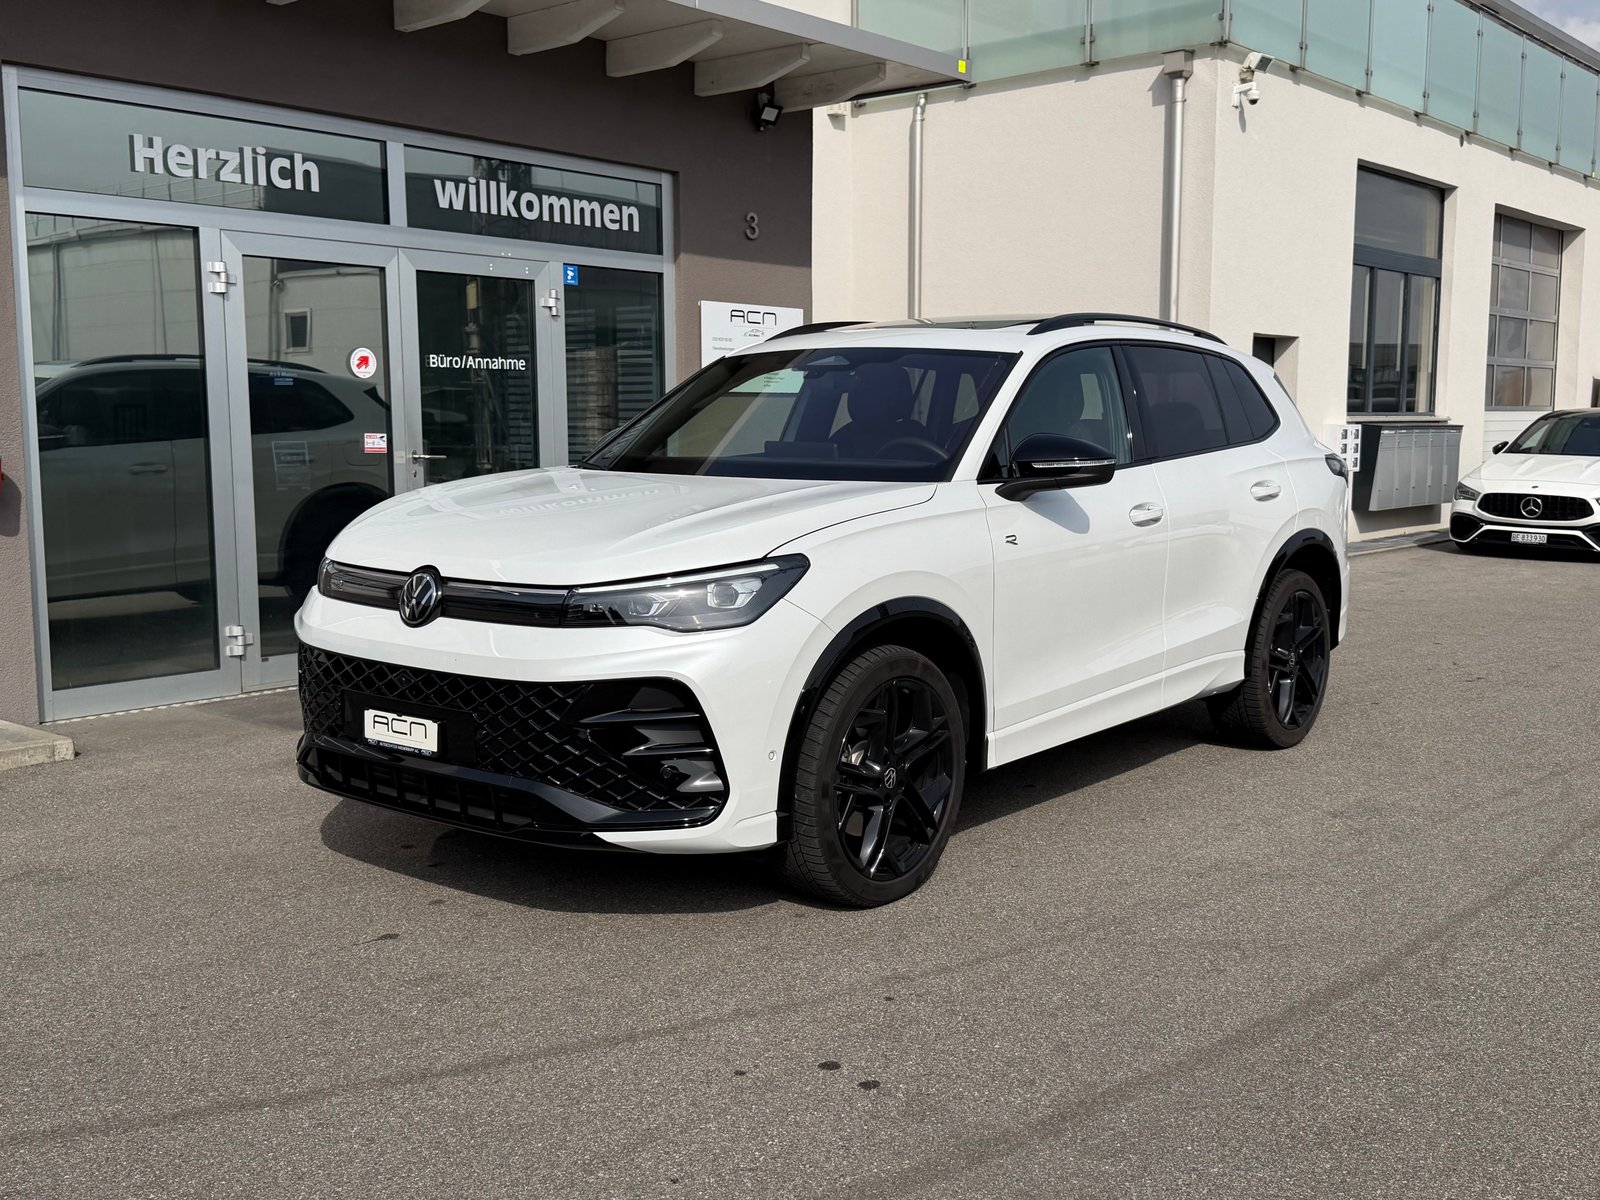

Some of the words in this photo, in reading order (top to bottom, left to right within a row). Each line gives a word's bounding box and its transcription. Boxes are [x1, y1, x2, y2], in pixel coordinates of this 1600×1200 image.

[132, 133, 320, 193] Herzlich
[433, 176, 640, 232] willkommen
[745, 212, 759, 240] 3
[730, 309, 777, 326] ACN
[428, 354, 526, 371] Büro/Annahme
[373, 714, 427, 739] ACN
